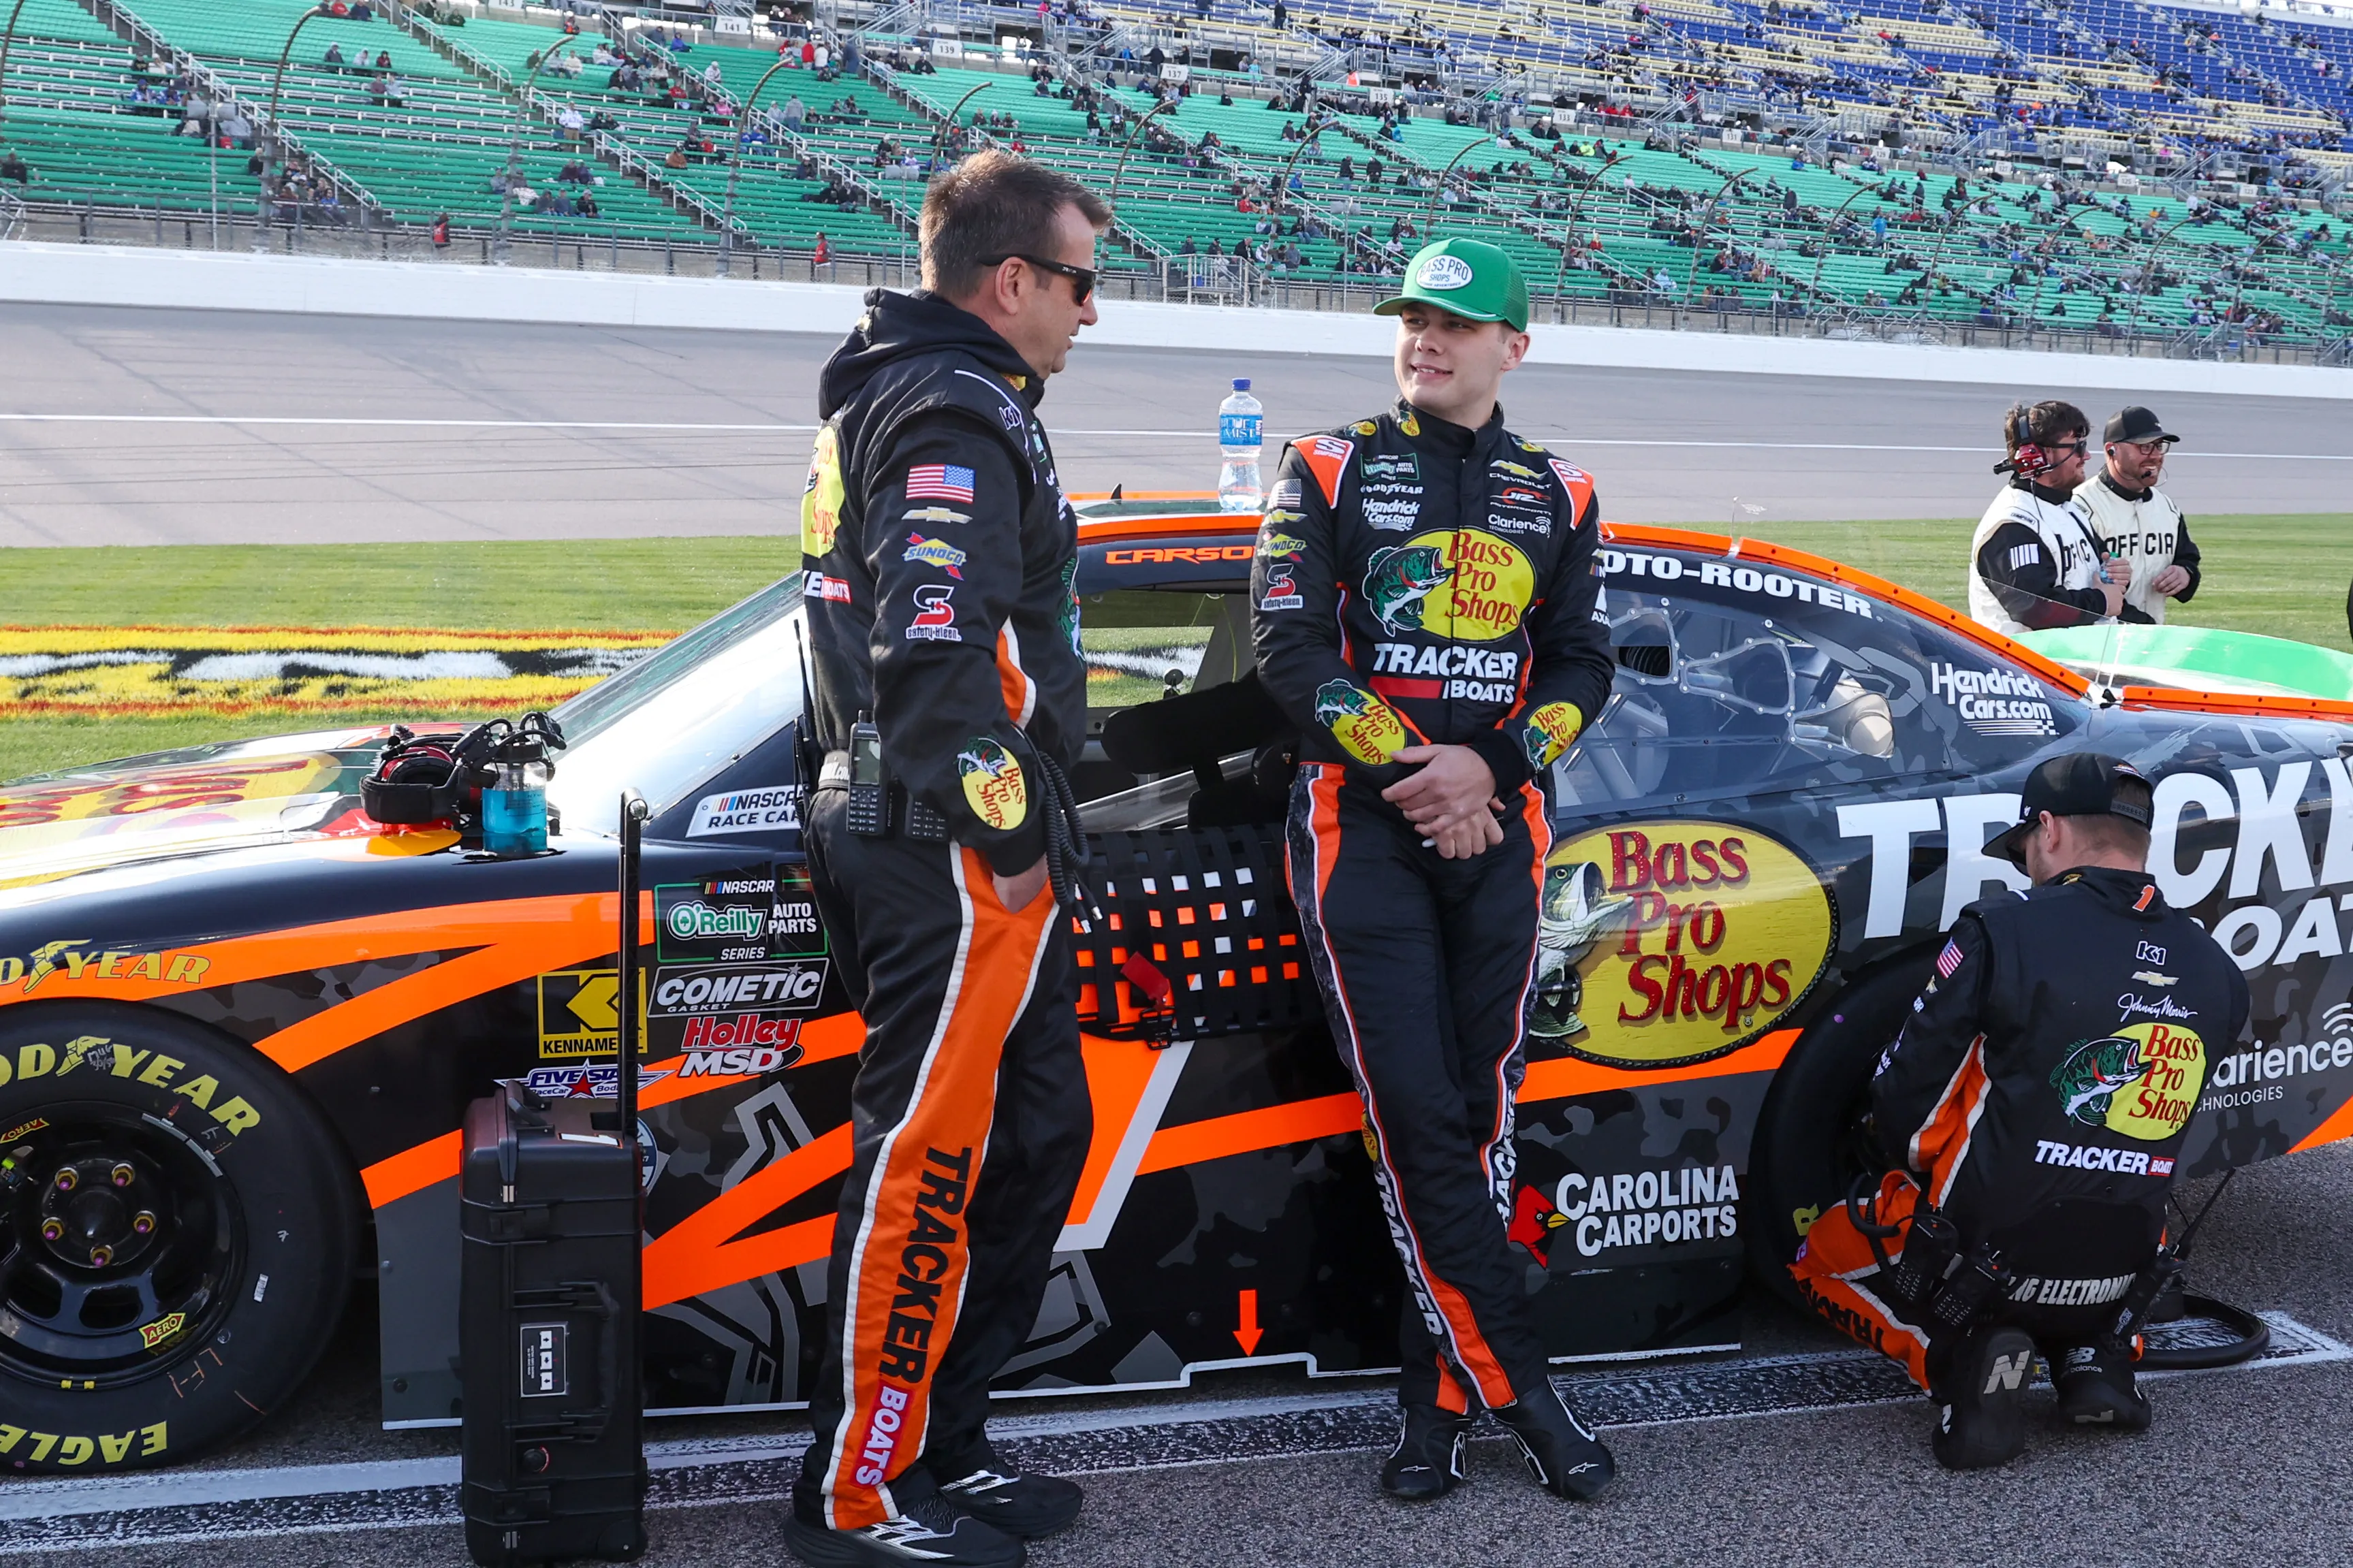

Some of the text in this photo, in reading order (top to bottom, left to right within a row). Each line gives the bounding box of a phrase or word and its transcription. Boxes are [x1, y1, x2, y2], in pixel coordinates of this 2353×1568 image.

[725, 22, 740, 32] 141
[939, 45, 955, 54] 139
[1168, 69, 1182, 78] 137
[1375, 92, 1388, 101] 135
[1559, 112, 1570, 121] 133
[1726, 133, 1737, 141] 131
[1419, 257, 1469, 281] BASS PRO
[1430, 274, 1451, 282] SHOPS
[1361, 483, 1423, 495] GOODYEAR
[1489, 473, 1552, 490] CHEVROLET
[1362, 498, 1421, 516] Hendrick
[1368, 513, 1415, 524] Cars.com
[1488, 514, 1547, 534] Clarience
[906, 547, 964, 566] SUNOCO
[1105, 545, 1257, 564] CARSO
[1263, 540, 1306, 551] SUNOCO
[1447, 532, 1514, 566] Bass
[824, 578, 849, 600] BOATS
[1449, 562, 1496, 592] Pro
[1605, 550, 1874, 619] OTO-ROOTER
[1444, 589, 1520, 630] Shops
[1372, 642, 1519, 679] TRACKER
[1450, 679, 1515, 704] BOATS
[1931, 662, 2045, 705] Hendrick
[1368, 704, 1402, 735] Bass
[1535, 703, 1566, 729] Bass
[1959, 694, 2053, 720] Cars.com
[1357, 714, 1385, 739] Pro
[1548, 720, 1568, 741] Pro
[1344, 723, 1386, 765] Shops
[990, 776, 1011, 803] Pro
[1003, 767, 1026, 805] Bass
[975, 783, 1007, 829] Shops
[708, 812, 758, 829] RACE
[1835, 757, 2353, 940] TRCK
[1606, 830, 1749, 894] Bass
[721, 879, 775, 894] NASCAR
[669, 901, 812, 940] O'Reilly AUTO
[768, 918, 817, 935] PARTS
[1616, 890, 1726, 957] Pro
[720, 946, 765, 961] SERIES
[2136, 940, 2167, 965] K1
[656, 970, 821, 1007] COMETIC
[1617, 953, 1793, 1029] Shops
[667, 1003, 731, 1013] GASKET
[543, 1037, 644, 1054] KENNAME
[681, 1014, 802, 1051] Holley
[2143, 1025, 2200, 1062] Bass
[679, 1047, 784, 1077] MSD
[2139, 1057, 2184, 1091] Pro
[2205, 1037, 2353, 1089] arience
[531, 1068, 618, 1086] FIVE STA
[2128, 1089, 2192, 1130] Shops
[2197, 1085, 2284, 1113] HNOLOGIES
[7, 1119, 37, 1138] AERO
[2034, 1139, 2151, 1176] TRACKER
[1556, 1164, 1740, 1221] CAROLINA
[1575, 1205, 1737, 1257] CARPORTS
[879, 1146, 973, 1385] TRACKER
[1374, 1171, 1444, 1337] TRACKER
[148, 1317, 178, 1341] AERO
[0, 1420, 168, 1465] EAGLE
[855, 1386, 909, 1486] BOATS
